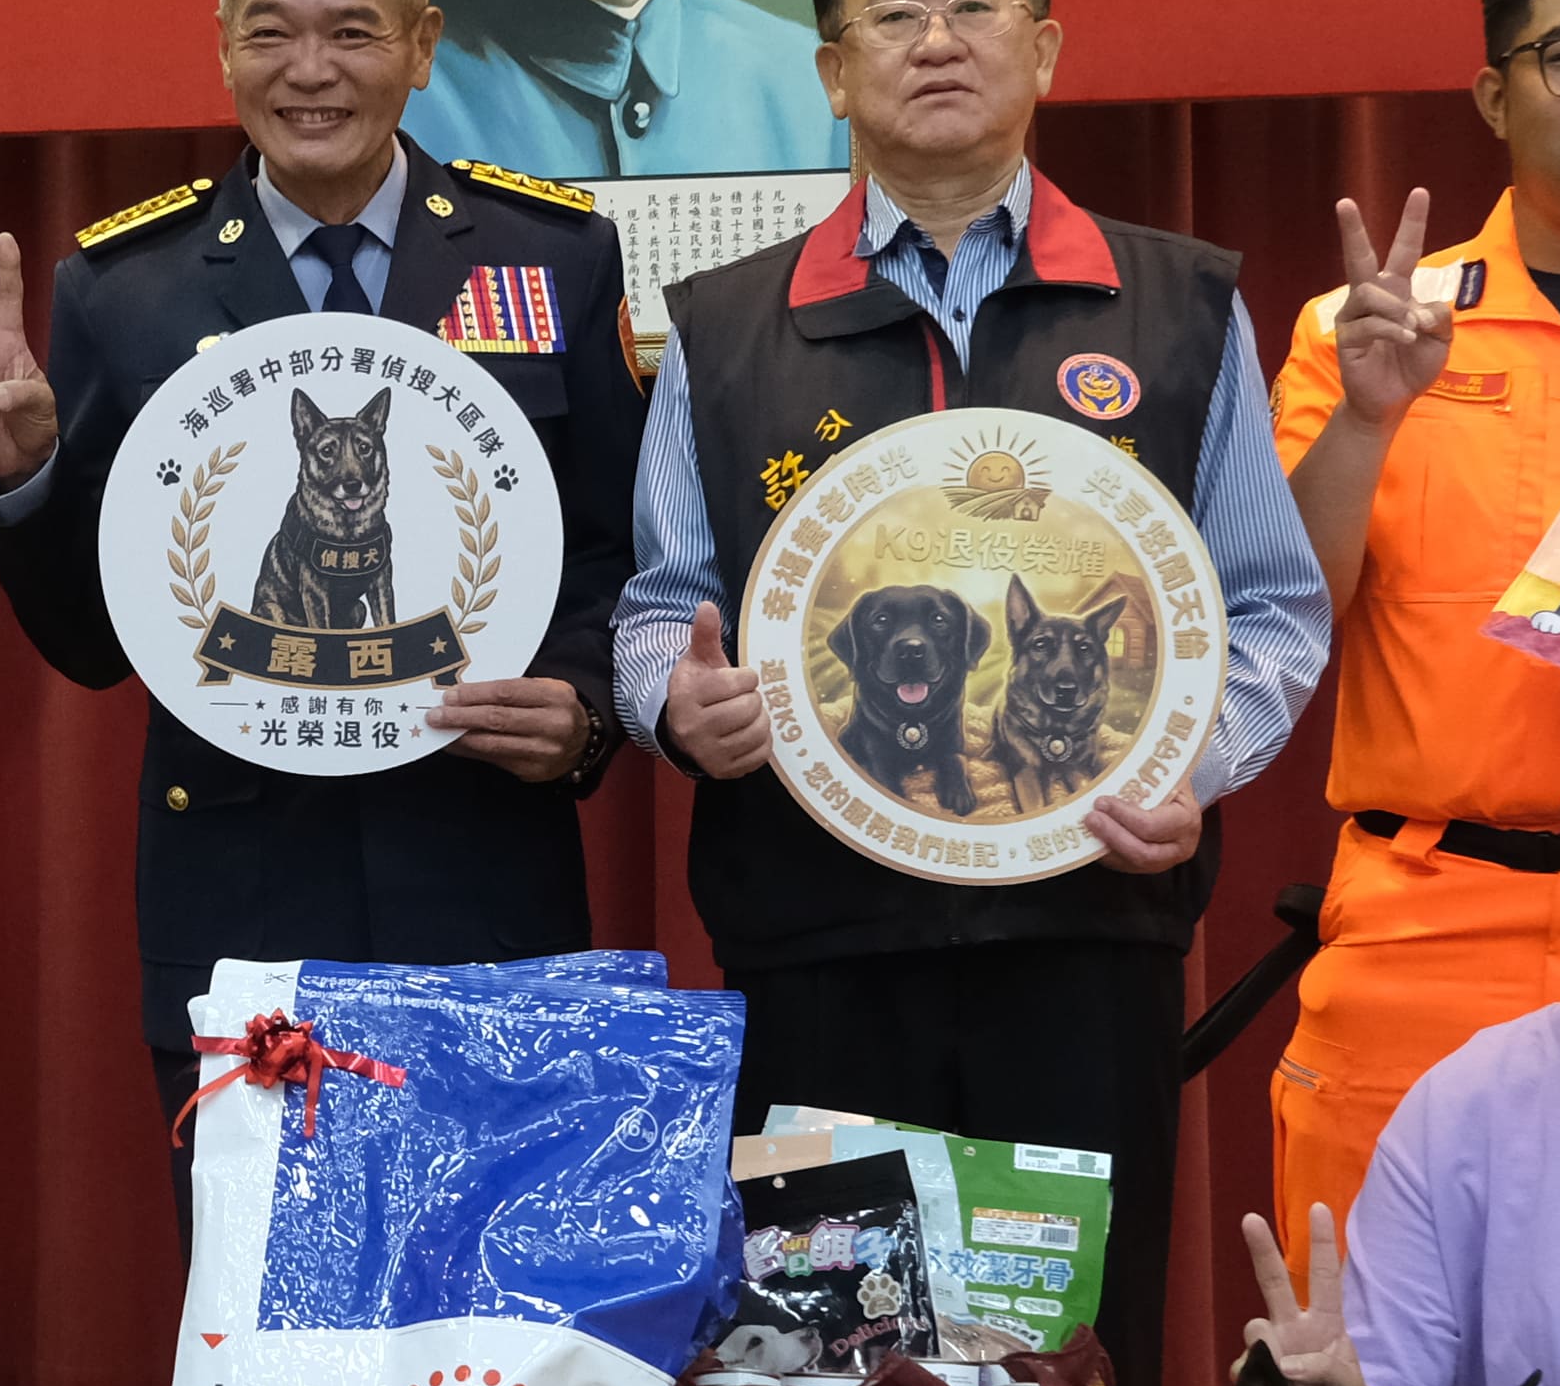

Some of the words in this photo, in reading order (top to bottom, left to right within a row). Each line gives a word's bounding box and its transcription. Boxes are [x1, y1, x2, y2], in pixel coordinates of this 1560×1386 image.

[792, 202, 807, 235] 余致
[178, 345, 505, 460] 海巡署中部分署偵搜犬區隊
[761, 445, 920, 622] 幸福養老時光
[873, 522, 1107, 580] K9退役榮耀
[320, 547, 381, 570] 偵搜犬
[1079, 463, 1210, 661] 共享悠閒天倫
[266, 633, 394, 680] 露西
[280, 696, 384, 716] 感謝有你
[260, 719, 401, 750] 光榮退役
